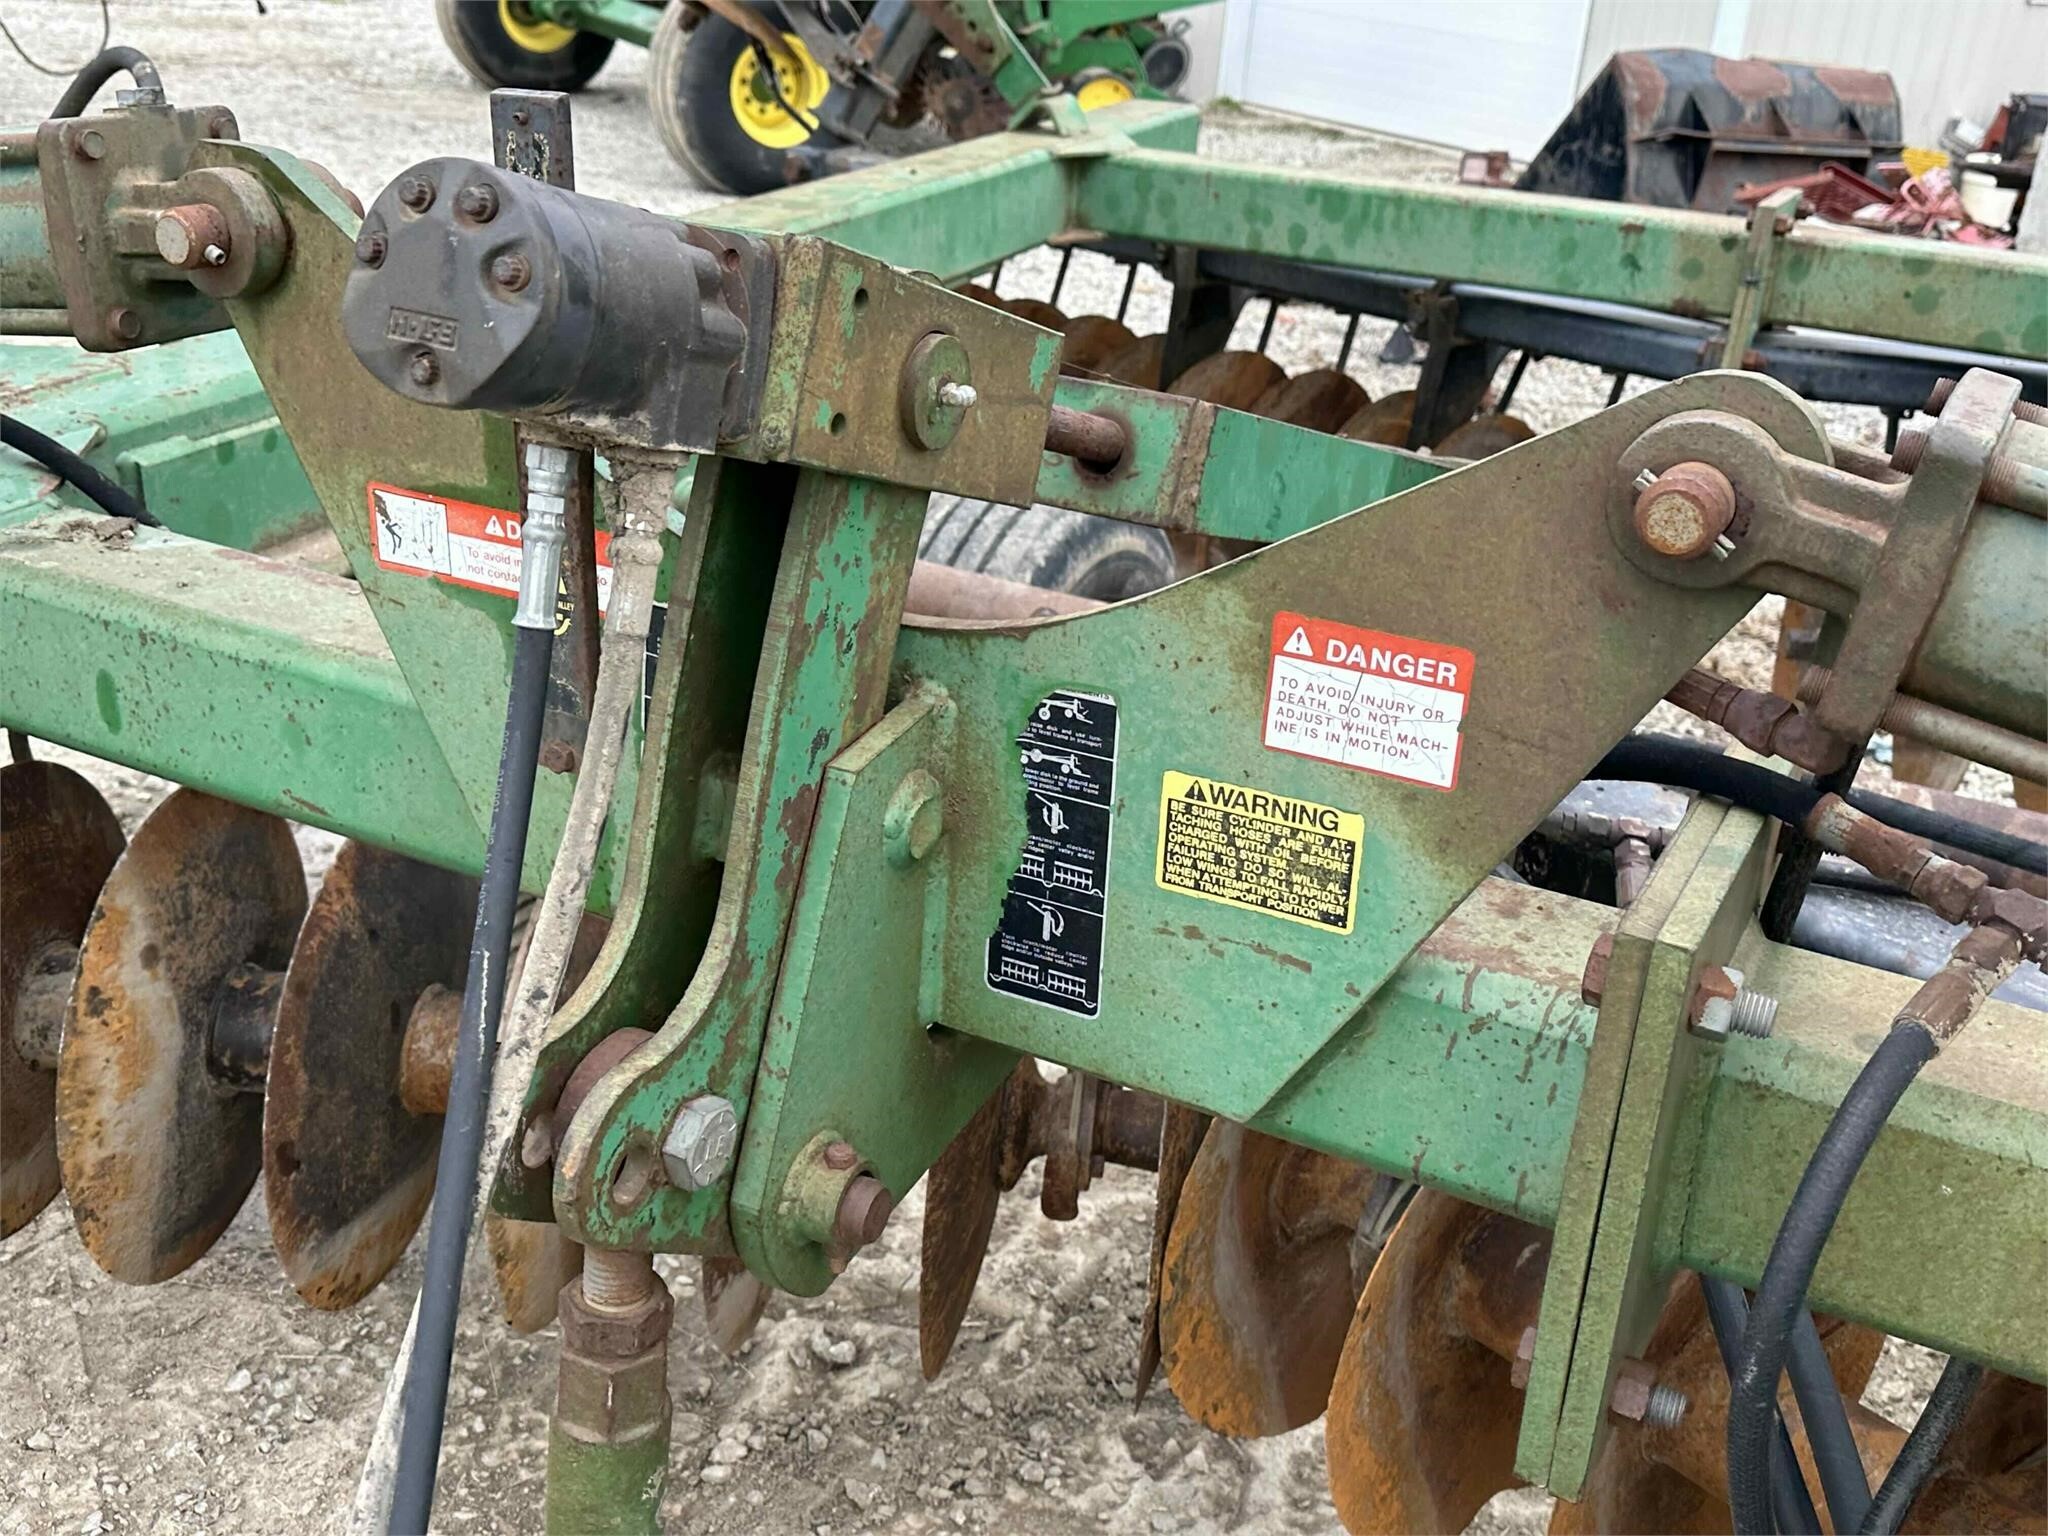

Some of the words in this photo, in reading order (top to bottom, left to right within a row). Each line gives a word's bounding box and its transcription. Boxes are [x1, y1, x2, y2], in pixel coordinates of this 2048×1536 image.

[467, 546, 479, 557] To
[483, 550, 510, 564] avoid
[468, 565, 484, 574] not
[487, 569, 521, 583] contac
[1325, 639, 1458, 686] DANGER
[1279, 677, 1298, 689] TO
[1305, 682, 1351, 700] AVOID
[1360, 694, 1415, 713] INJURY
[1422, 707, 1444, 720] OR
[1338, 704, 1360, 717] DO
[1367, 711, 1400, 726] NOT
[1274, 720, 1297, 733] INE
[1304, 727, 1318, 738] IS
[1325, 732, 1340, 743] IN
[1348, 737, 1409, 758] MOTION
[1276, 707, 1332, 727] ADJUST
[1340, 721, 1388, 739] WHILE
[1396, 733, 1448, 752] MACH-
[1170, 801, 1186, 812] BE
[1191, 806, 1223, 820] SURE
[1228, 815, 1290, 836] CYLINDER
[1296, 830, 1324, 844] AND
[1207, 783, 1339, 832] WARNING
[1168, 832, 1236, 856] OPERATING
[1168, 822, 1227, 843] CHARGED
[1235, 838, 1265, 852] WITH
[1272, 847, 1293, 859] OIL
[1300, 854, 1349, 873] BEFORE
[1169, 811, 1221, 831] TACHING
[1229, 826, 1271, 843] HOSES
[1278, 837, 1303, 851] ARE
[1310, 845, 1350, 862] FULLY
[1166, 853, 1193, 867] LOW
[1196, 860, 1236, 877] WINGS
[1240, 871, 1256, 882] TO
[1260, 876, 1288, 890] FALL
[1167, 842, 1215, 861] FAILURE
[1220, 856, 1237, 867] TO
[1243, 861, 1262, 873] DO
[1268, 867, 1285, 879] SO
[1291, 873, 1321, 888] WILL
[1165, 873, 1194, 887] FROM
[1198, 881, 1263, 904] TRANSPORT
[1166, 863, 1200, 879] WHEN
[1202, 872, 1279, 899] ATTEMPTING
[1282, 892, 1297, 904] TO
[1301, 897, 1344, 915] LOWER
